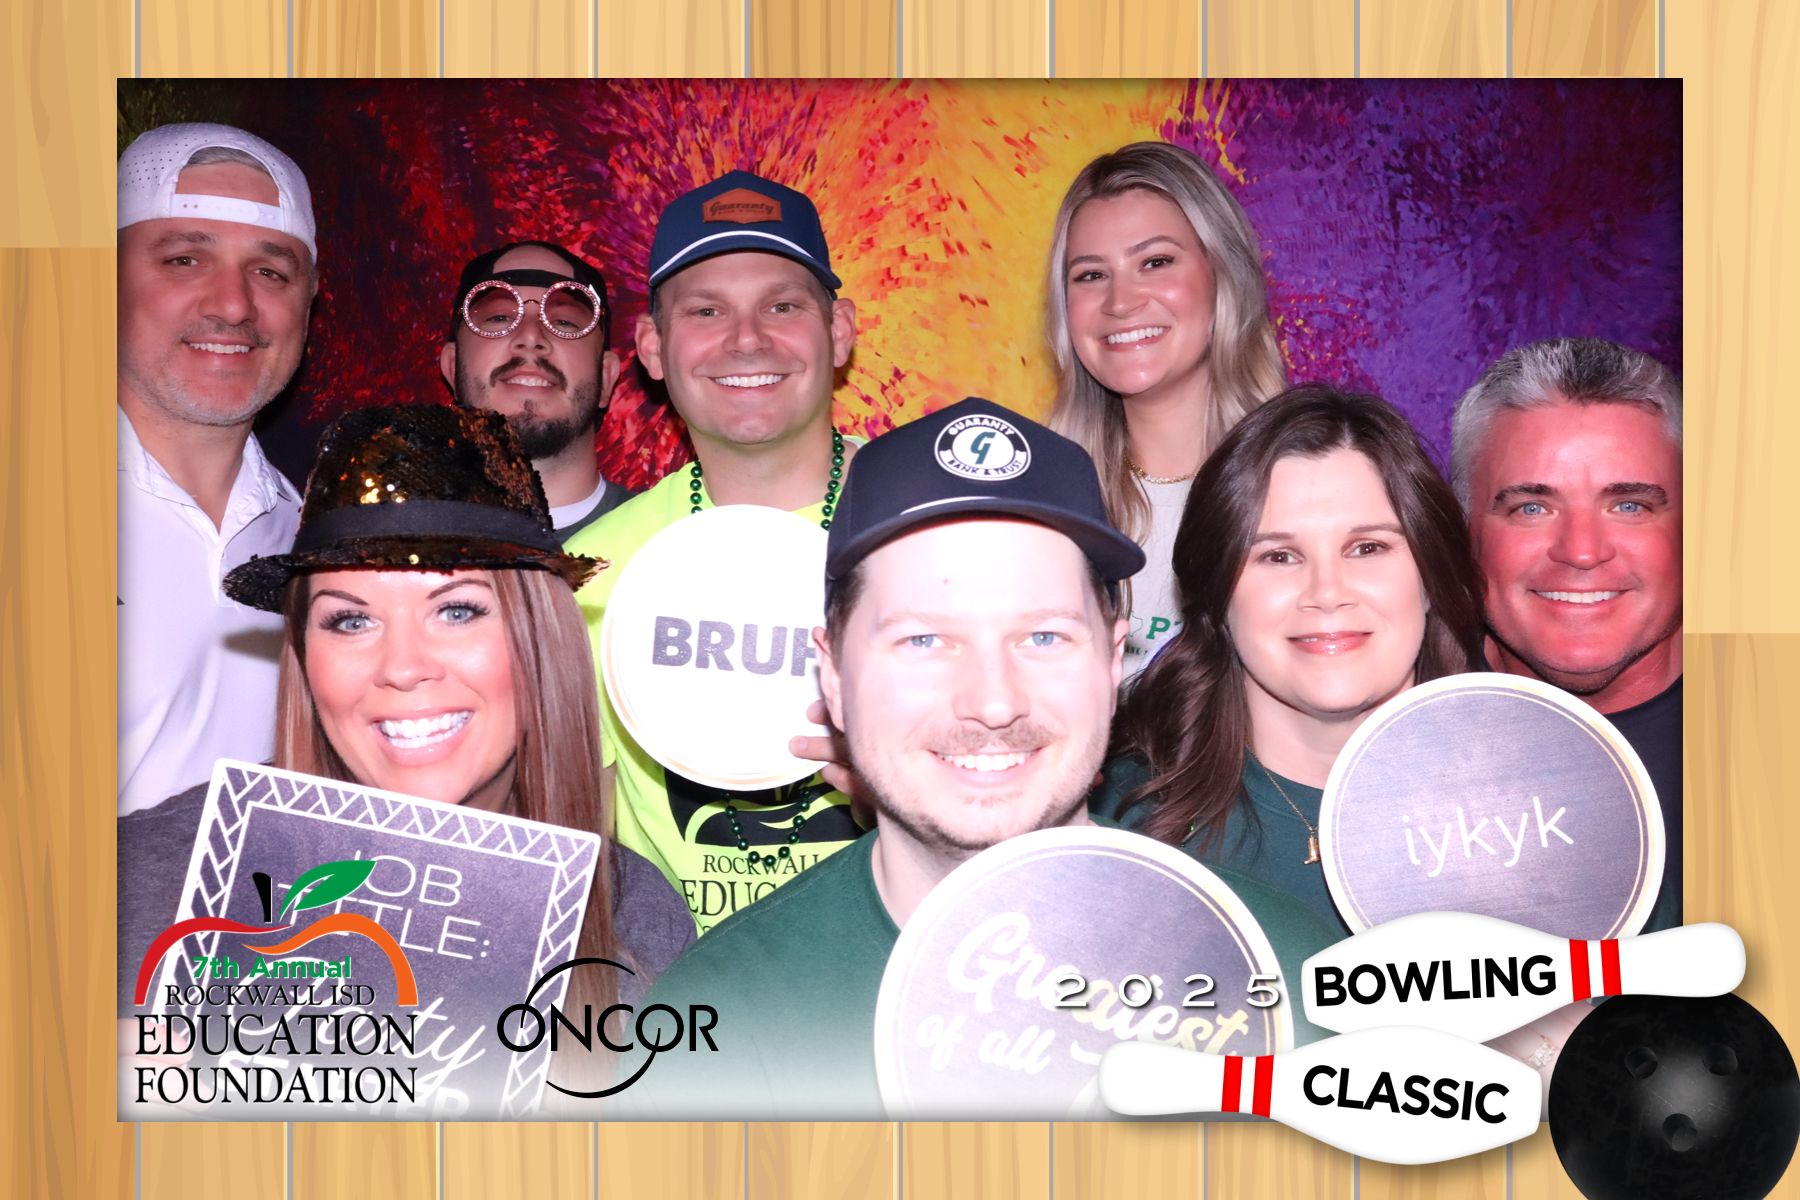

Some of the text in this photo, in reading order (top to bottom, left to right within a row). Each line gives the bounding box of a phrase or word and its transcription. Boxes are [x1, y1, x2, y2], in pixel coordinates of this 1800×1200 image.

[709, 201, 774, 217] Guaranty
[948, 417, 1015, 436] GUARANTY
[947, 459, 980, 475] BANK
[994, 459, 1023, 475] TRUST
[1402, 796, 1574, 878] iykyk
[916, 1013, 1056, 1074] of all
